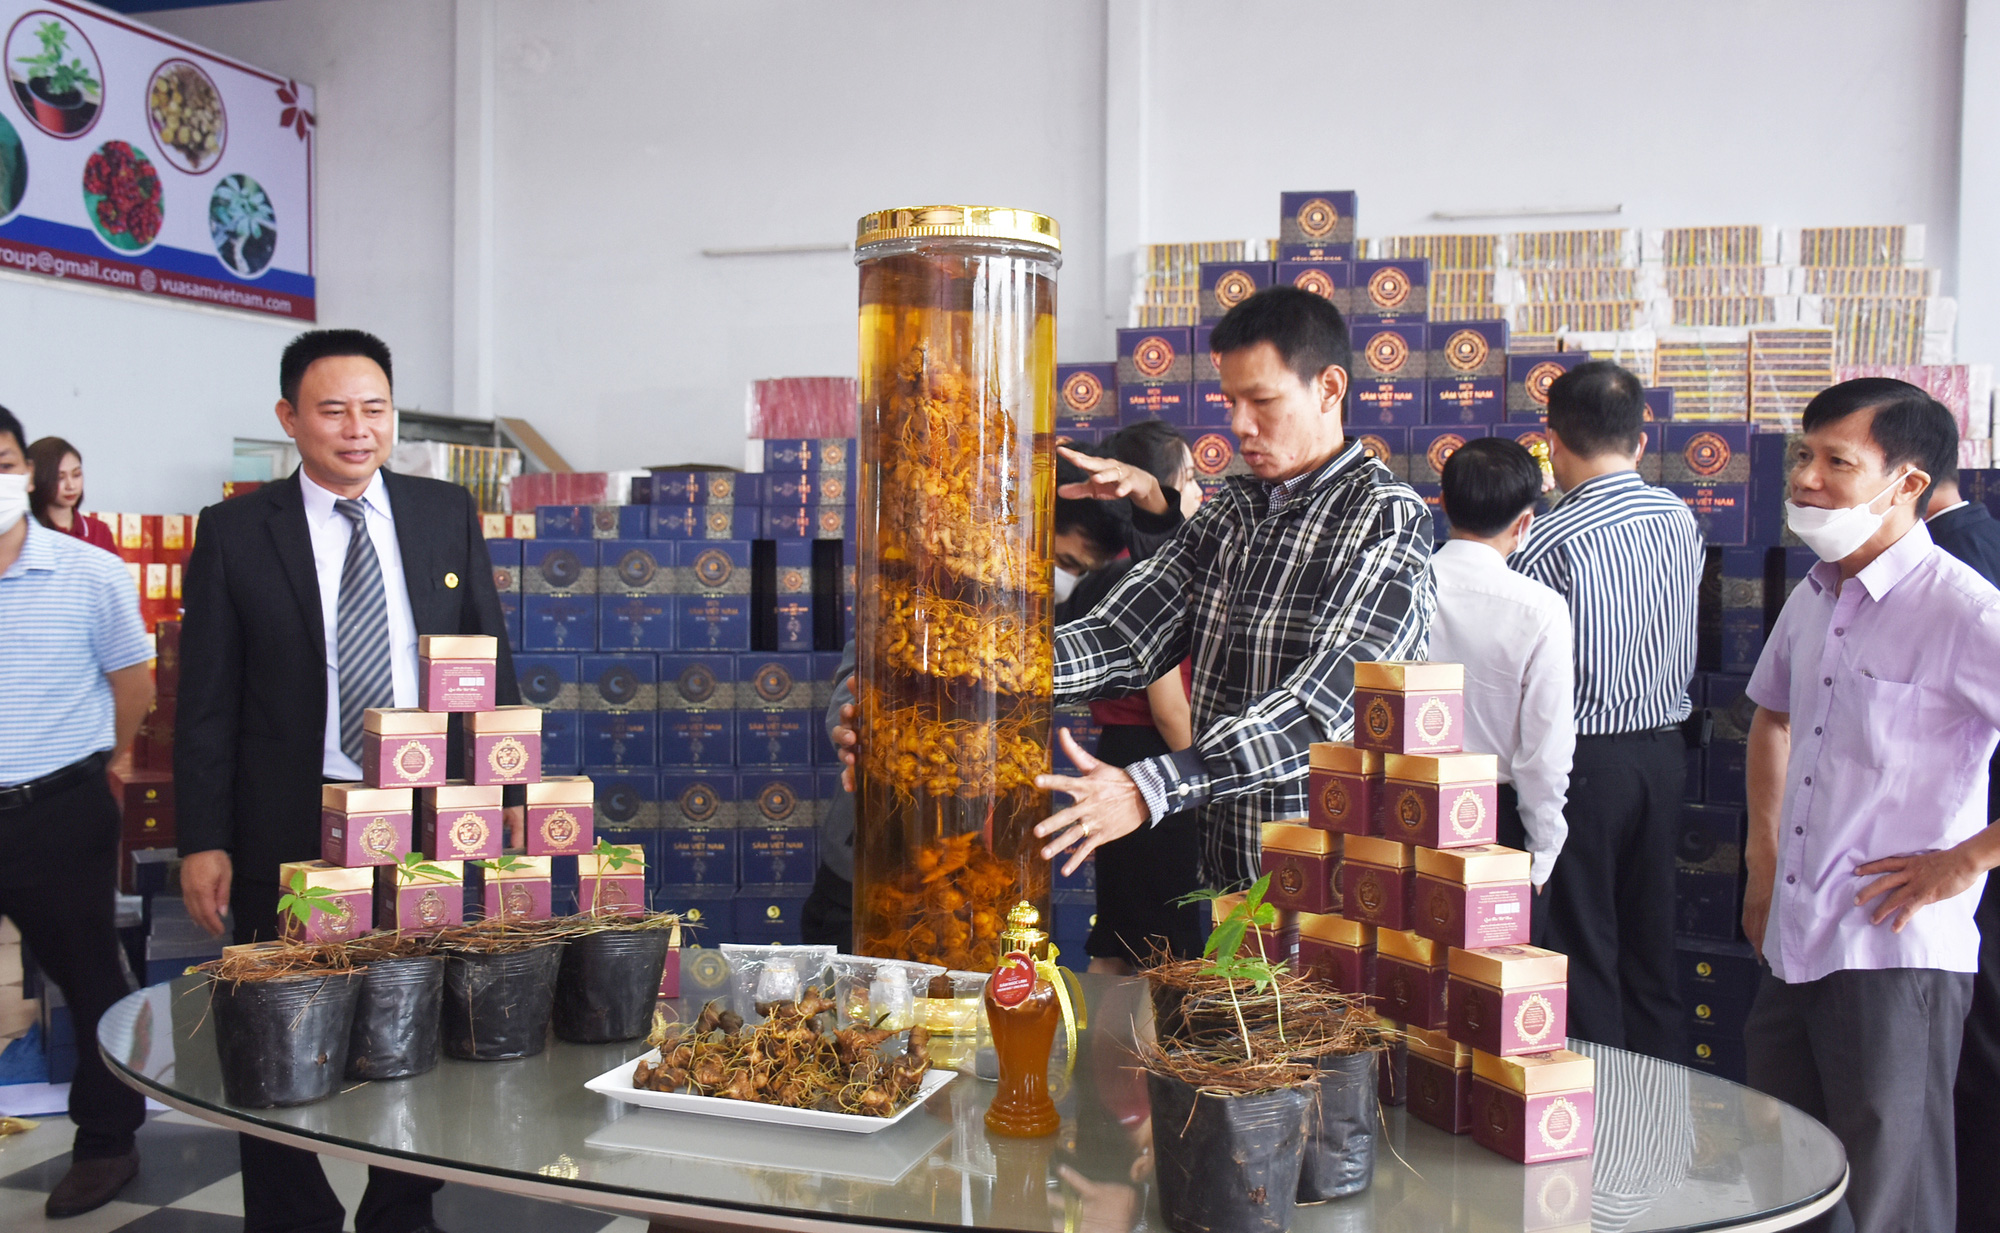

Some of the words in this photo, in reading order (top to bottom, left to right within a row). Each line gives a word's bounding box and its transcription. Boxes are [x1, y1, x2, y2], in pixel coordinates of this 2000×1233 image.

[160, 278, 292, 312] vuasamvietnam.com
[1394, 391, 1413, 400] NAM
[1474, 390, 1494, 399] NAM
[1714, 497, 1735, 506] NAM
